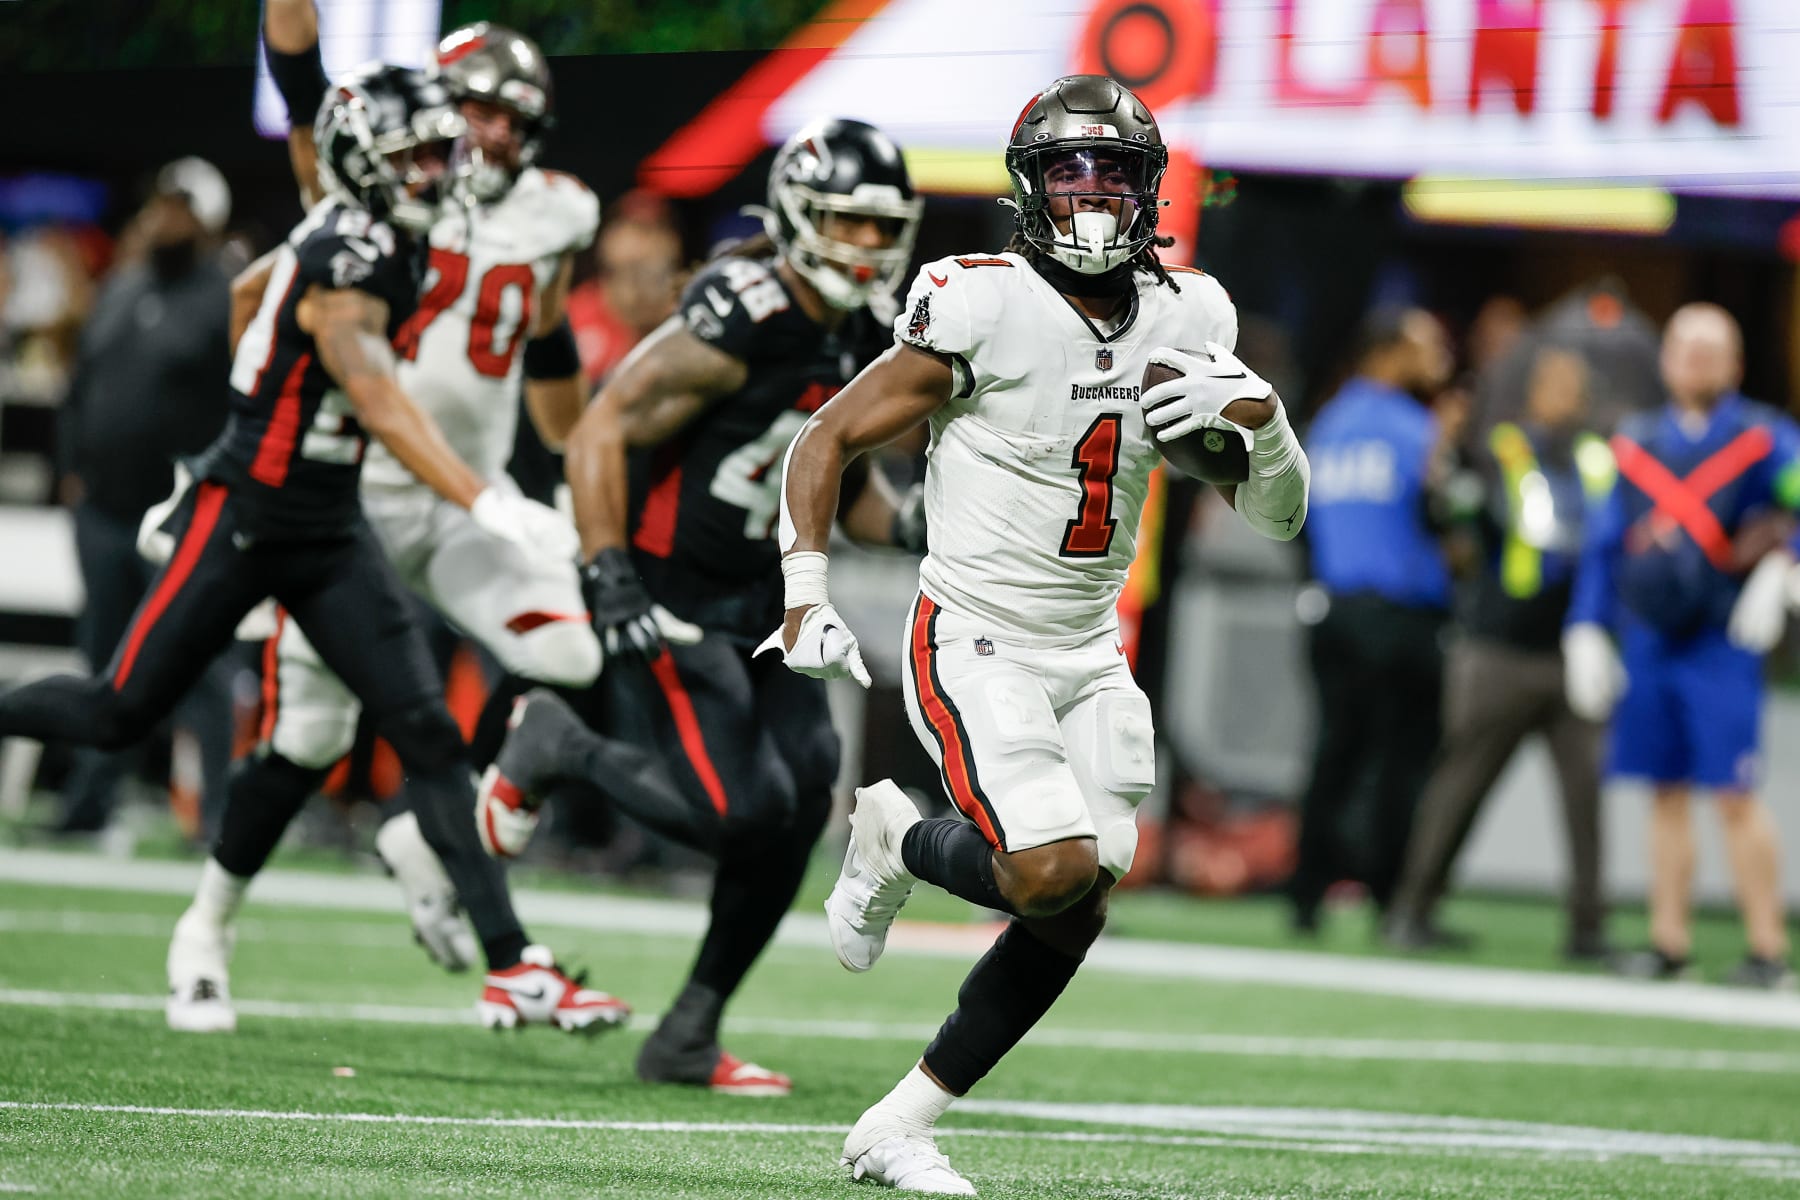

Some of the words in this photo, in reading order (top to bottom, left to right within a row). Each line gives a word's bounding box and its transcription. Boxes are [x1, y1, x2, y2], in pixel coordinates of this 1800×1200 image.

[1200, 0, 1741, 125] LANTA
[392, 248, 534, 377] 70
[1059, 412, 1123, 558] 1
